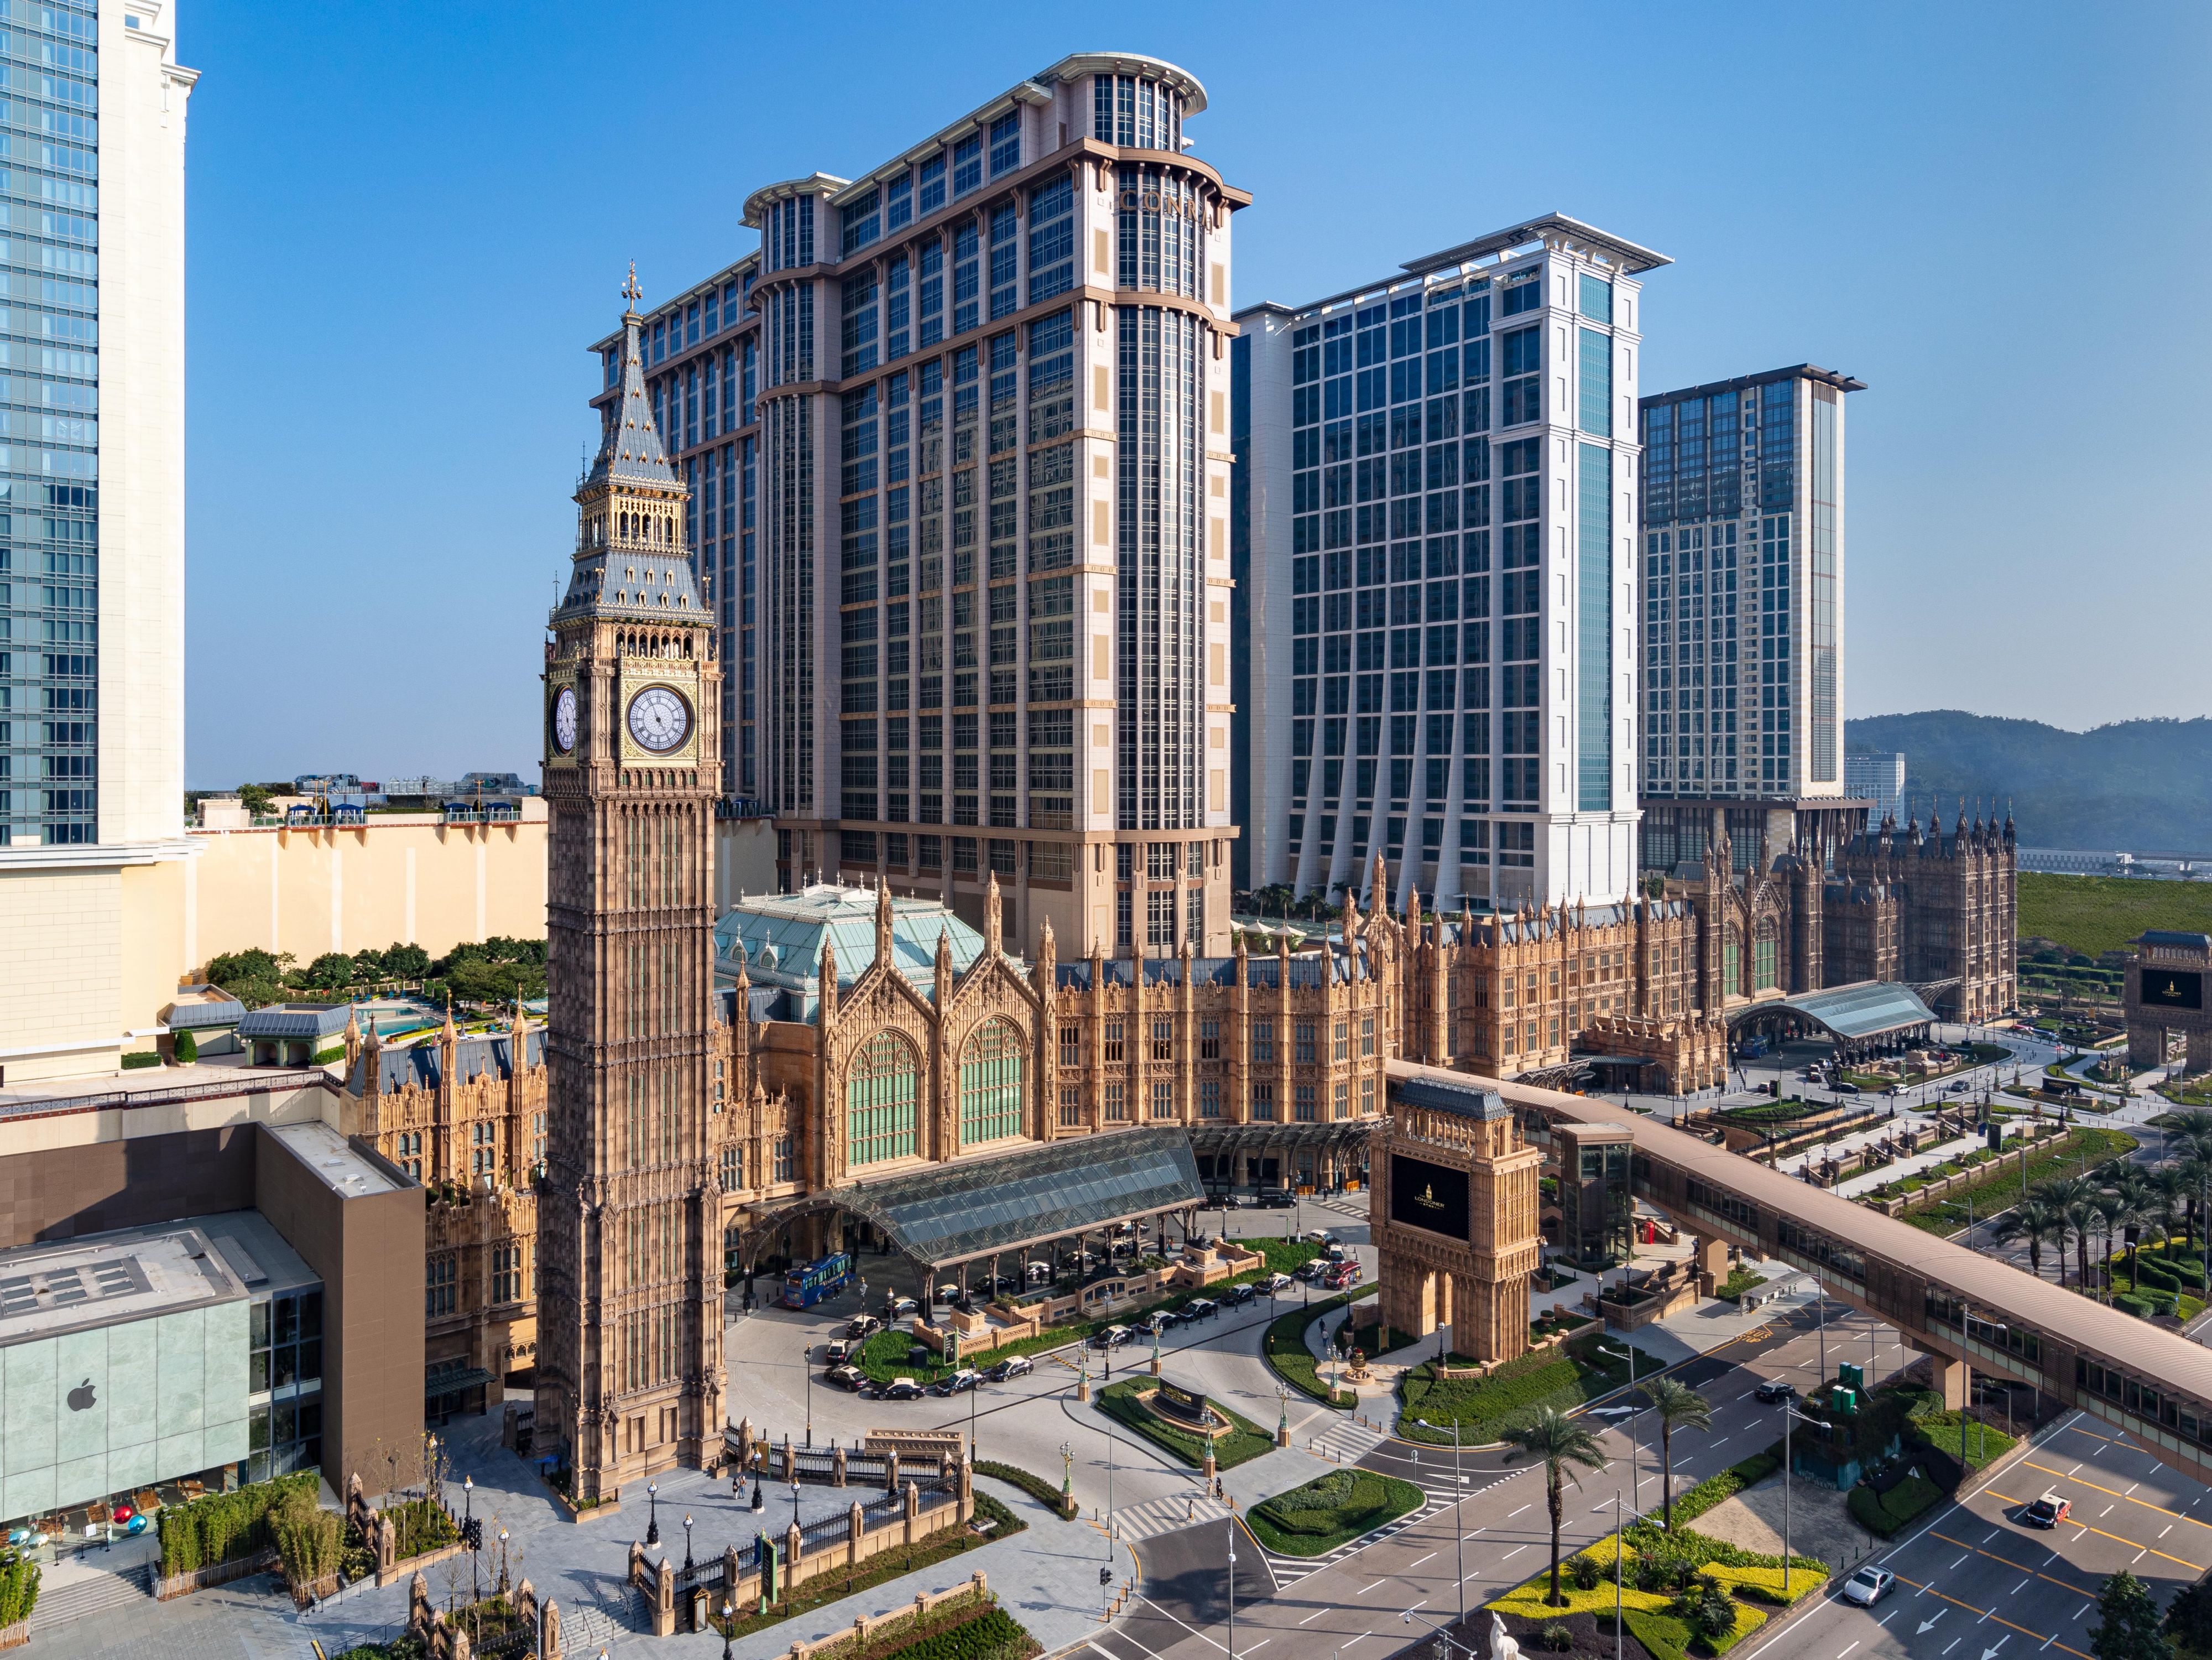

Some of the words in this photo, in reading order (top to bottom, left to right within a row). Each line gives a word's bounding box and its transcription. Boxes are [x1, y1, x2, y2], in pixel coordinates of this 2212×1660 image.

[1119, 189, 1213, 235] CONRAD
[1415, 1196, 1444, 1208] LONDONER
[1736, 1334, 1761, 1343] STOP
[1745, 1330, 1771, 1339] BUS
